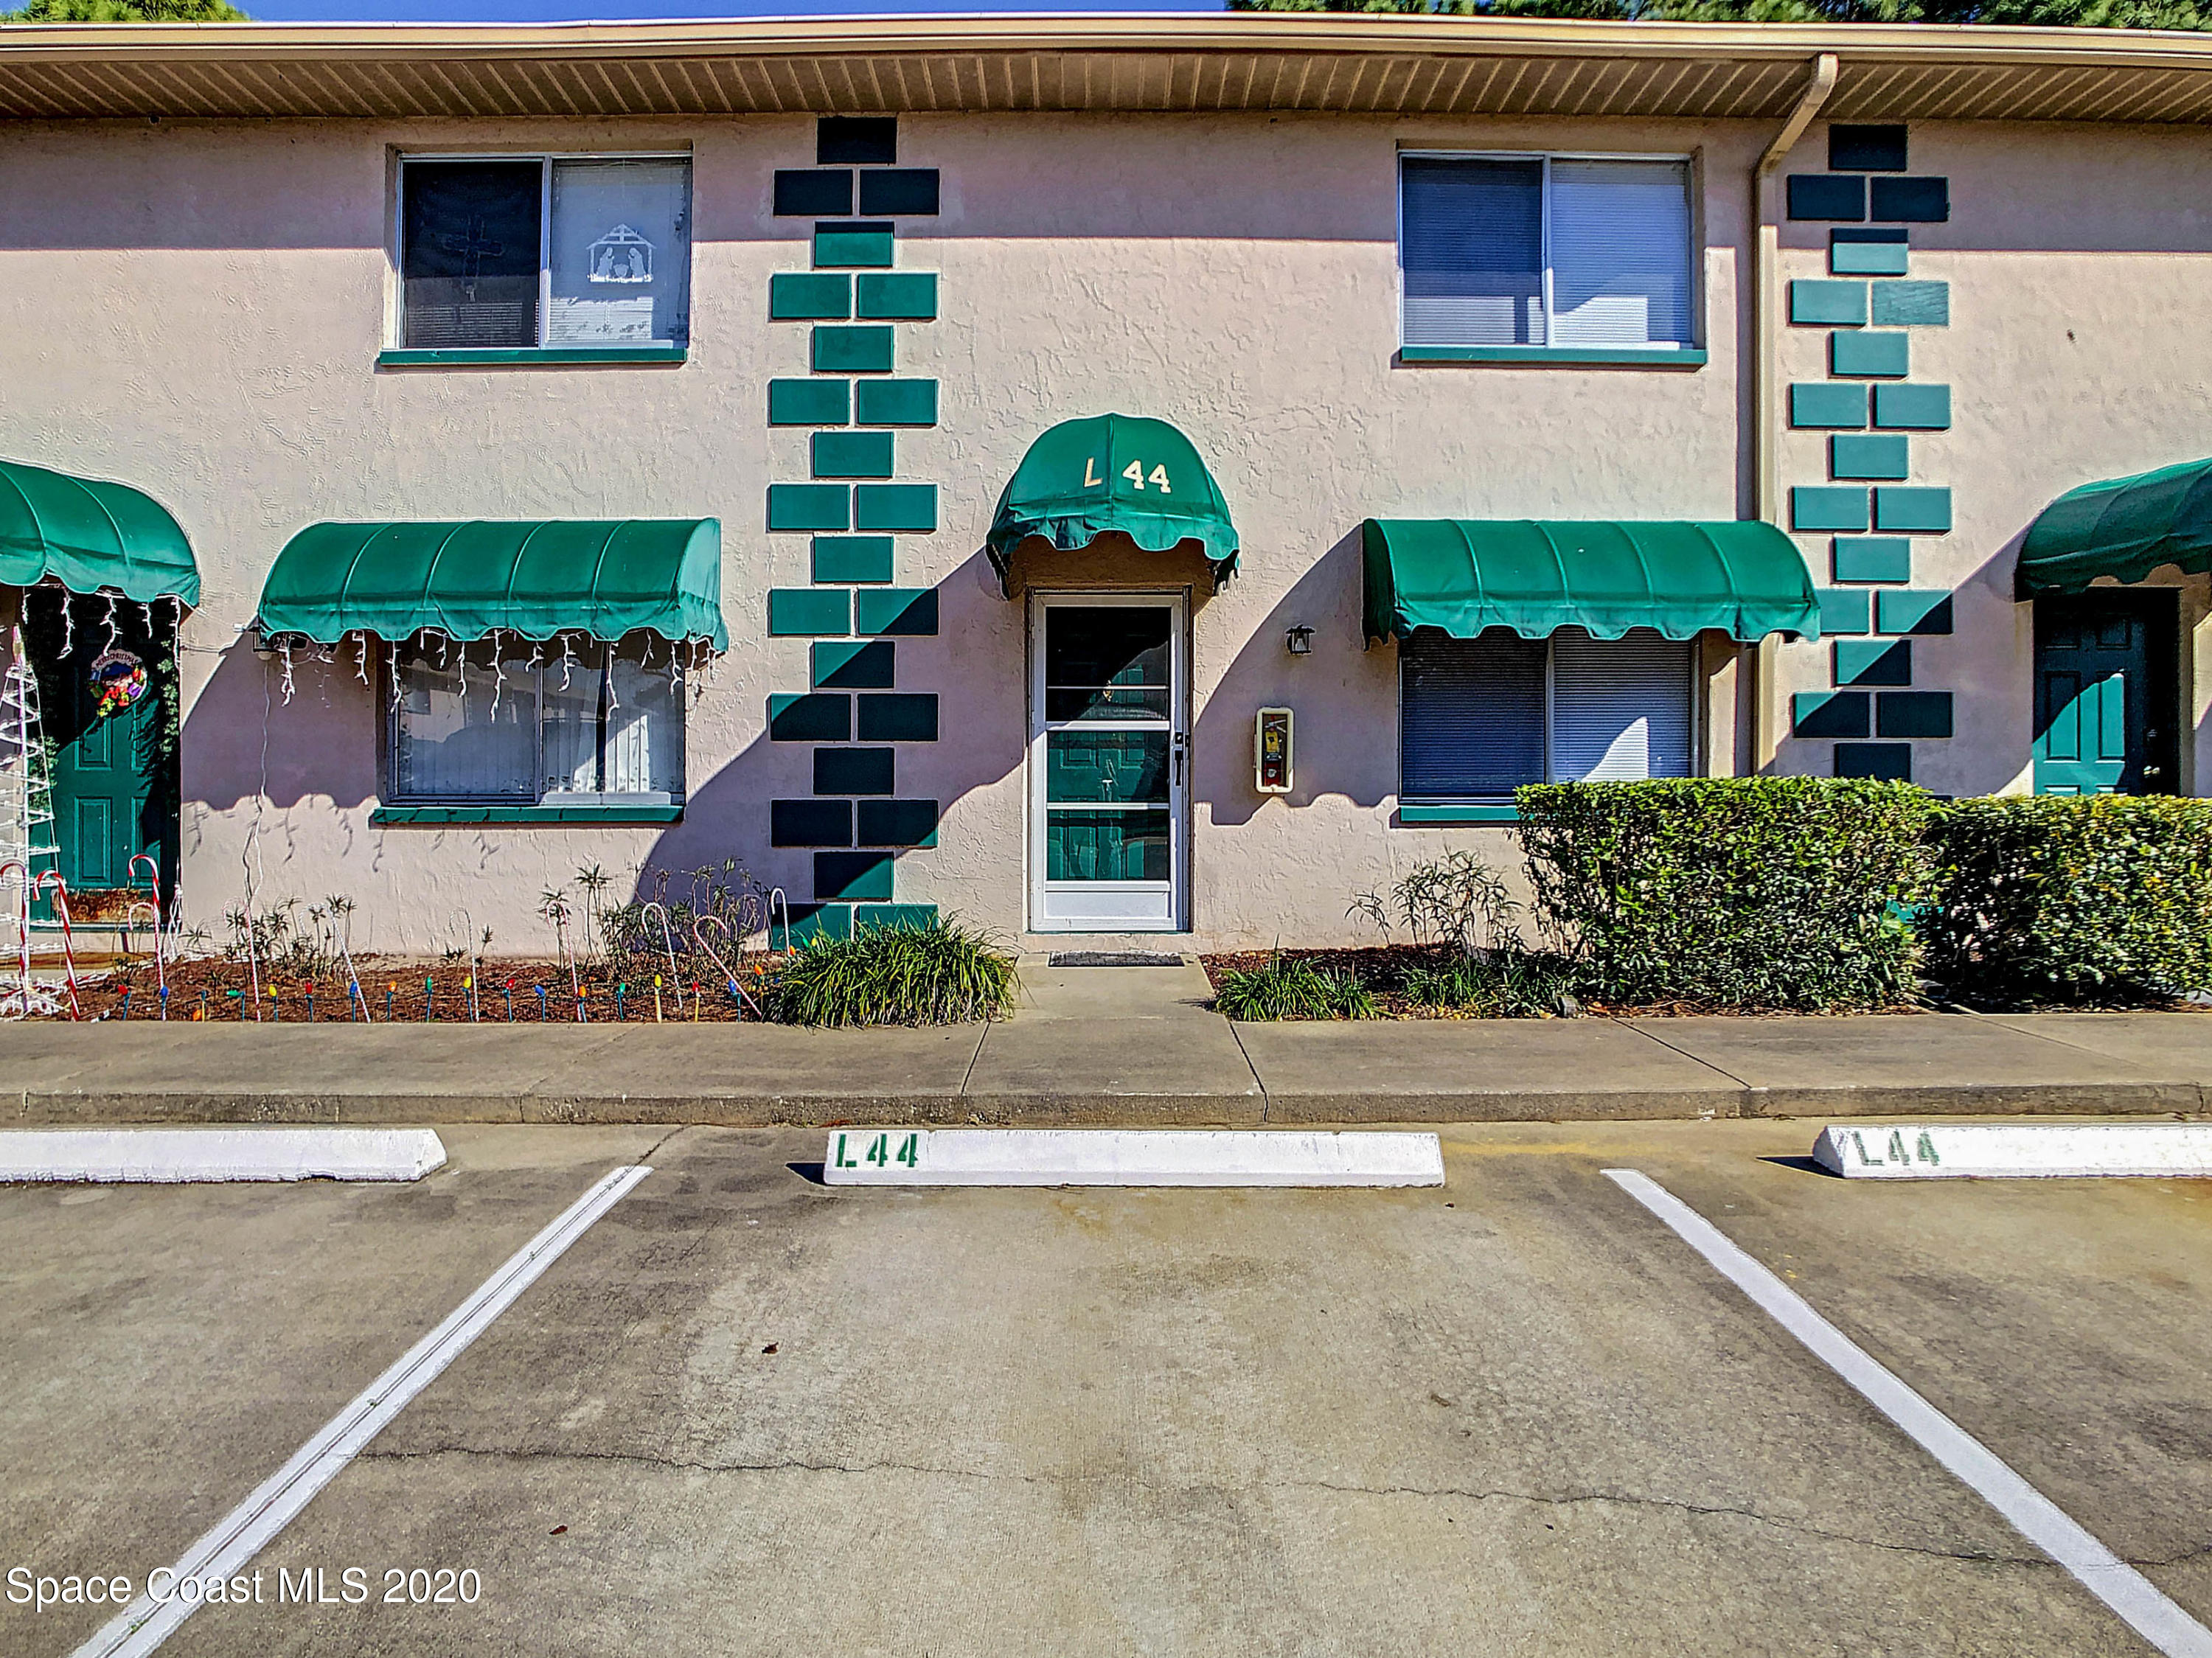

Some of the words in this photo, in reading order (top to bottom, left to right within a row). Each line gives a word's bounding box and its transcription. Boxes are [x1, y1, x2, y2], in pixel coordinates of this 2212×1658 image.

[1083, 457, 1103, 487] L
[1122, 459, 1172, 493] 44
[835, 1133, 919, 1167] L44
[1851, 1130, 1940, 1166] L44
